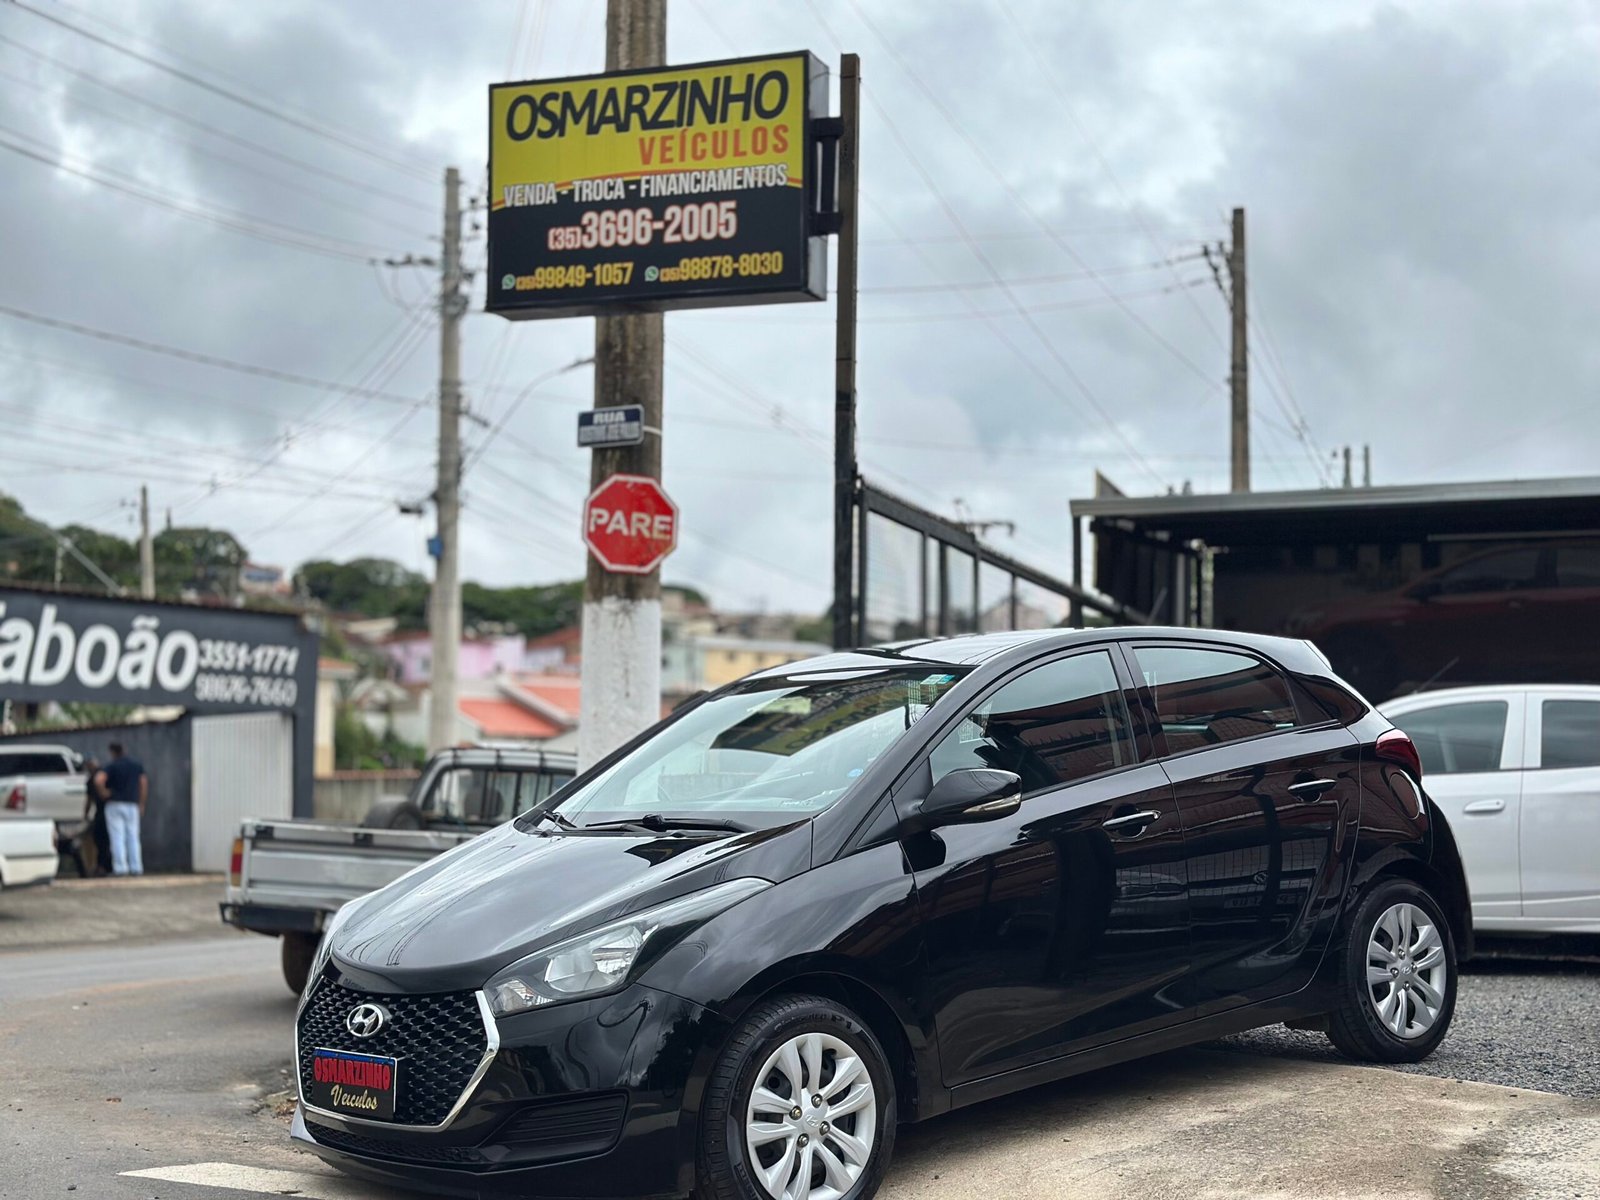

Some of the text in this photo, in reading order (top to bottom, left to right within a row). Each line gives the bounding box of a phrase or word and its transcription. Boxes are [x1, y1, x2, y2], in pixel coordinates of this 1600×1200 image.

[507, 71, 788, 141] OSMARZINHO
[639, 125, 789, 165] VEÍCULOS
[503, 183, 557, 207] VENDA
[573, 178, 625, 202] TROCA
[640, 164, 788, 197] FINANCIAMENTOS
[589, 508, 673, 540] PARE
[0, 601, 199, 692] aboão
[314, 1057, 391, 1090] OSMARZINHO
